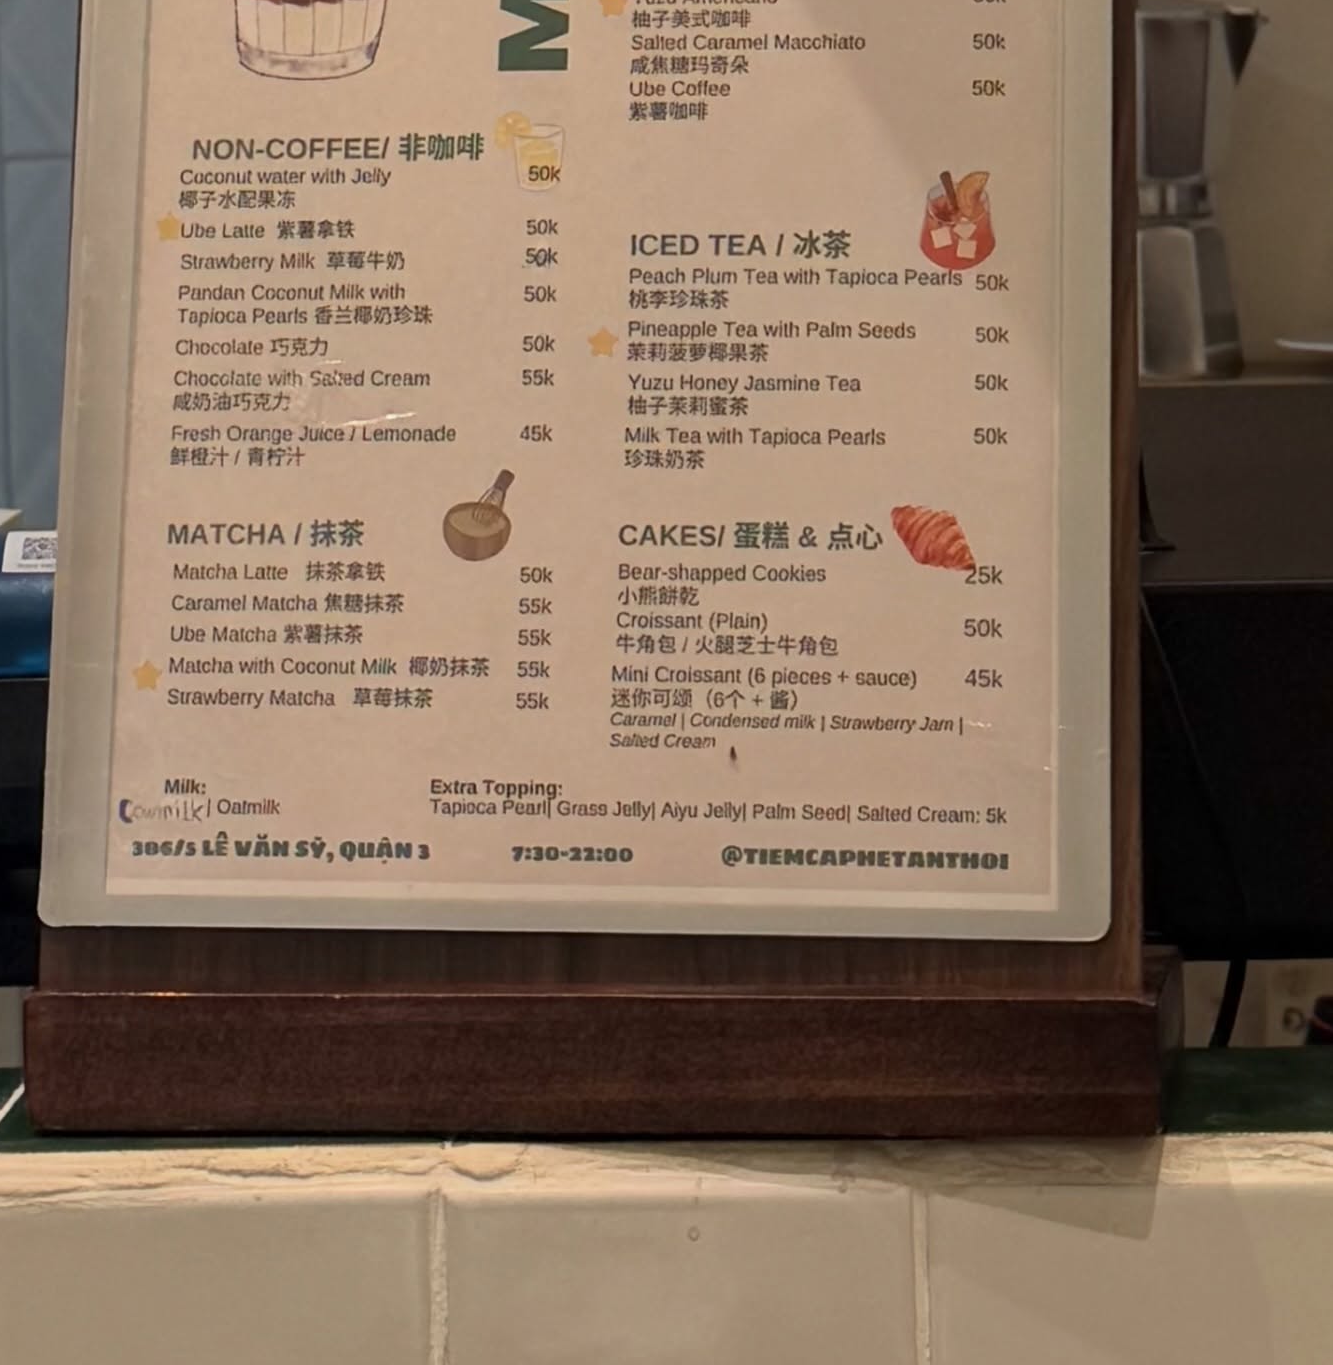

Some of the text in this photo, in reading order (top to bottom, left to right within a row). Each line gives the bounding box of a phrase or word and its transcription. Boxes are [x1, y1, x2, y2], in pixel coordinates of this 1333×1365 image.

[631, 33, 1006, 51] Salted Caramel Macchiato 50k
[629, 80, 1006, 97] Ube Coffee 50k
[192, 133, 485, 162] NON-COFFEE/ 非咖啡
[180, 166, 560, 188] Coconut water with Jelly 50k
[181, 219, 558, 239] Ube Latte 50k
[631, 229, 851, 259] ICED TEA 冰茶
[180, 247, 558, 273] Strawberry Milk 50k
[629, 267, 1009, 291] Peach Plum Tea with Tapioca Pearls 50k
[178, 283, 557, 303] Pandan Coconut Milk with 50k
[628, 289, 729, 310] 桃李珍珠茶
[178, 307, 308, 328] Tapioca Pearls
[628, 320, 1009, 343] Pineapple Tea with Palm Seeds 50k
[175, 335, 556, 357] Chocolate 巧克力 50k
[174, 368, 554, 387] Chocolate with Cream 55k
[628, 373, 1009, 397] Yuzu Honey Jasmine Tea 50k
[171, 424, 552, 447] Fresh Orange Juice Lemonade 45k
[624, 426, 1008, 448] Milk Tea with Tapioca Pearls 50k
[624, 449, 706, 470] 珍珠奶茶
[167, 519, 364, 548] MATCHA 抹茶
[618, 521, 883, 551] CAKES/ 蛋糕 点心
[173, 563, 553, 584] Matcha Latte 50k
[618, 563, 1002, 586] Bear-shapped Cookies 25k
[171, 594, 552, 615] Caramel Matcha 55k
[170, 625, 552, 646] Ube Matcha 55k
[616, 611, 1002, 638] Croissant (Plain) 50k
[169, 657, 550, 678] Matcha with Coconut Milk 55k
[611, 665, 1003, 688] Mini Croissant 45k
[167, 688, 549, 710] Strawberry Matcha 55k
[164, 778, 206, 795] Milk:
[430, 779, 564, 802] Extra Topping:
[217, 798, 280, 815] Oatmilk
[429, 798, 497, 818] Tapioca
[857, 805, 1007, 824] Salted 5k
[132, 831, 430, 864] 306/5 LÊ VĂN SỸ, QUẬN 3
[511, 846, 633, 862] 7:30-22:00
[721, 845, 1009, 870] @TIEMCAPHETANTHOI
